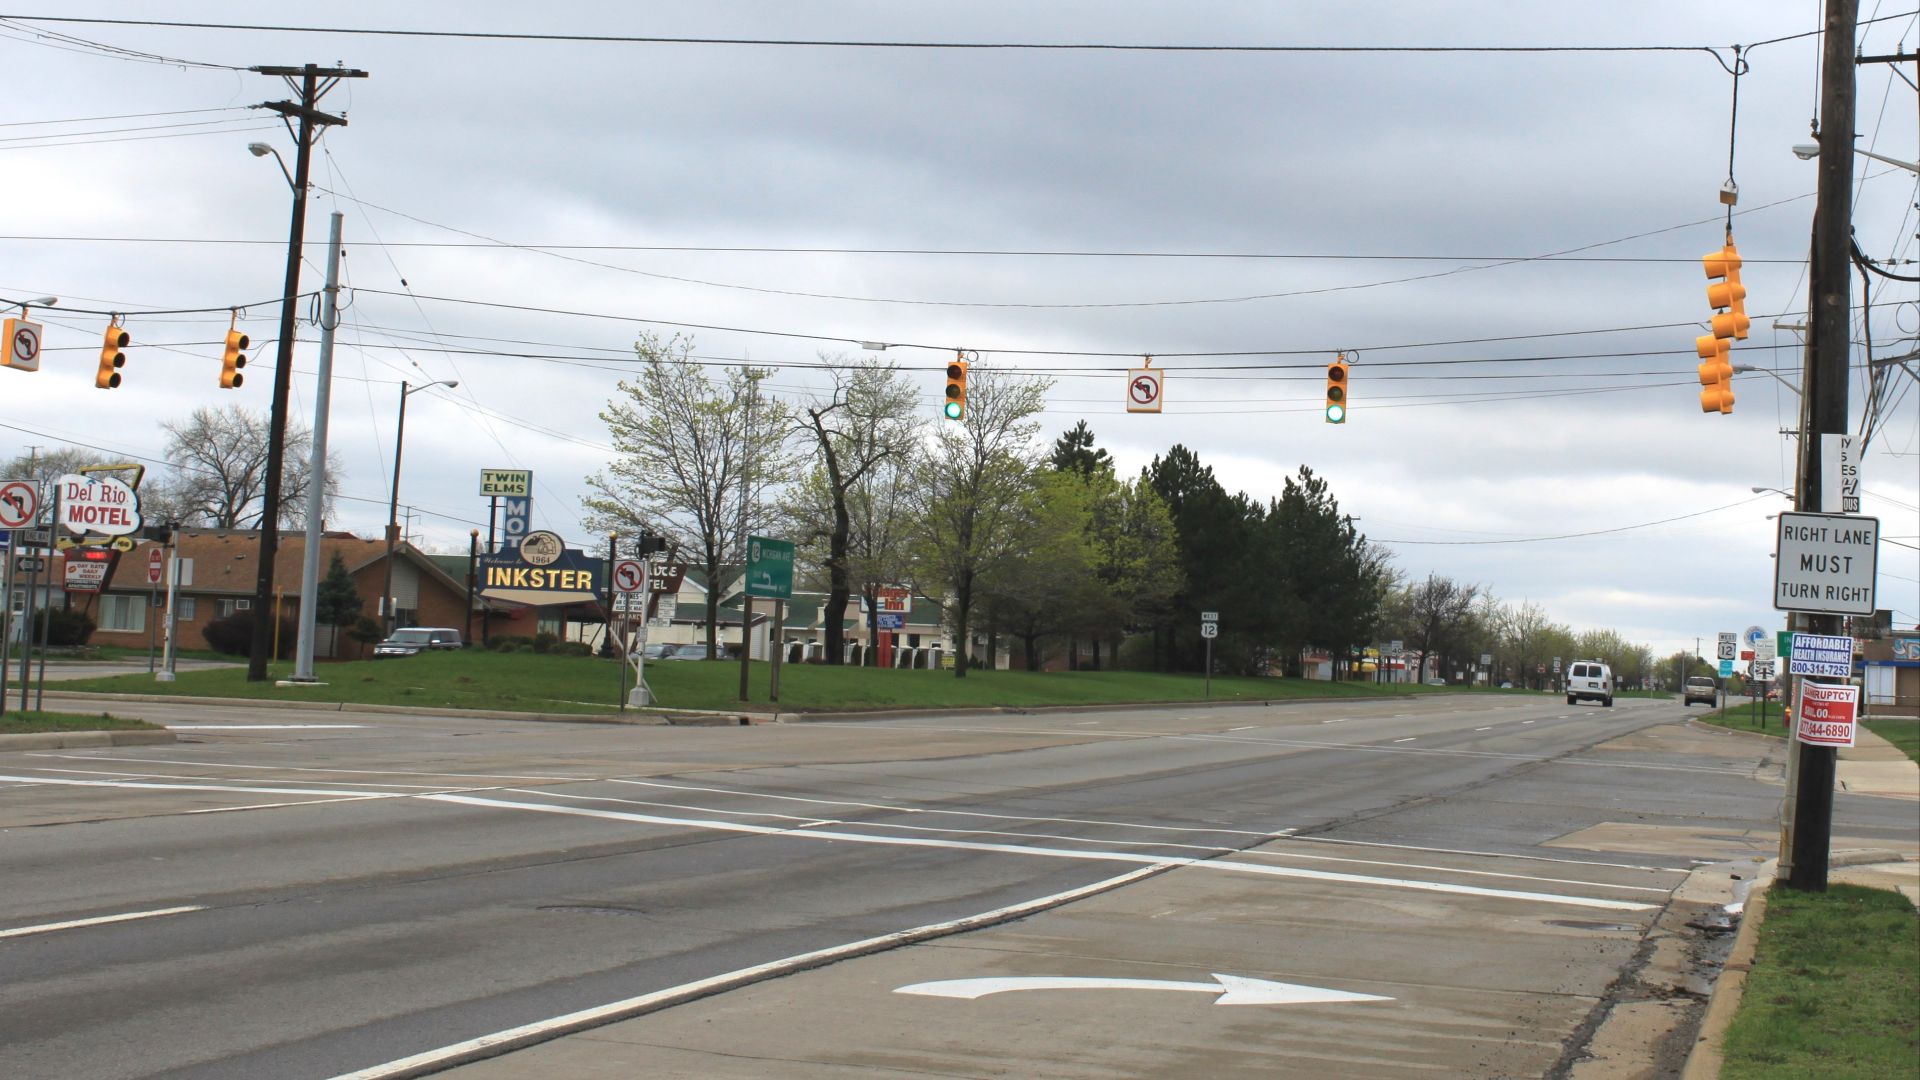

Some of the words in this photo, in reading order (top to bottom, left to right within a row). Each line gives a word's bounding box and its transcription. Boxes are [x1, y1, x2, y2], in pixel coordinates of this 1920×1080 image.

[483, 472, 526, 482] TWIN
[67, 482, 92, 501] Del
[101, 485, 126, 504] Rio
[483, 483, 525, 493] ELMS
[68, 505, 131, 526] MOTEL
[1784, 525, 1828, 543] RIGHT
[1834, 528, 1872, 546] LANE
[531, 555, 551, 564] 1964
[1799, 553, 1853, 575] MUST
[486, 567, 593, 590] INKSTER
[1781, 582, 1820, 600] TURN
[1826, 585, 1870, 603] RIGHT
[1204, 625, 1215, 635] 12
[1721, 646, 1733, 656] 12
[1795, 634, 1850, 651] AFFORDABLE
[1793, 648, 1815, 661] HEALTH
[1815, 650, 1849, 663] INSURANCE
